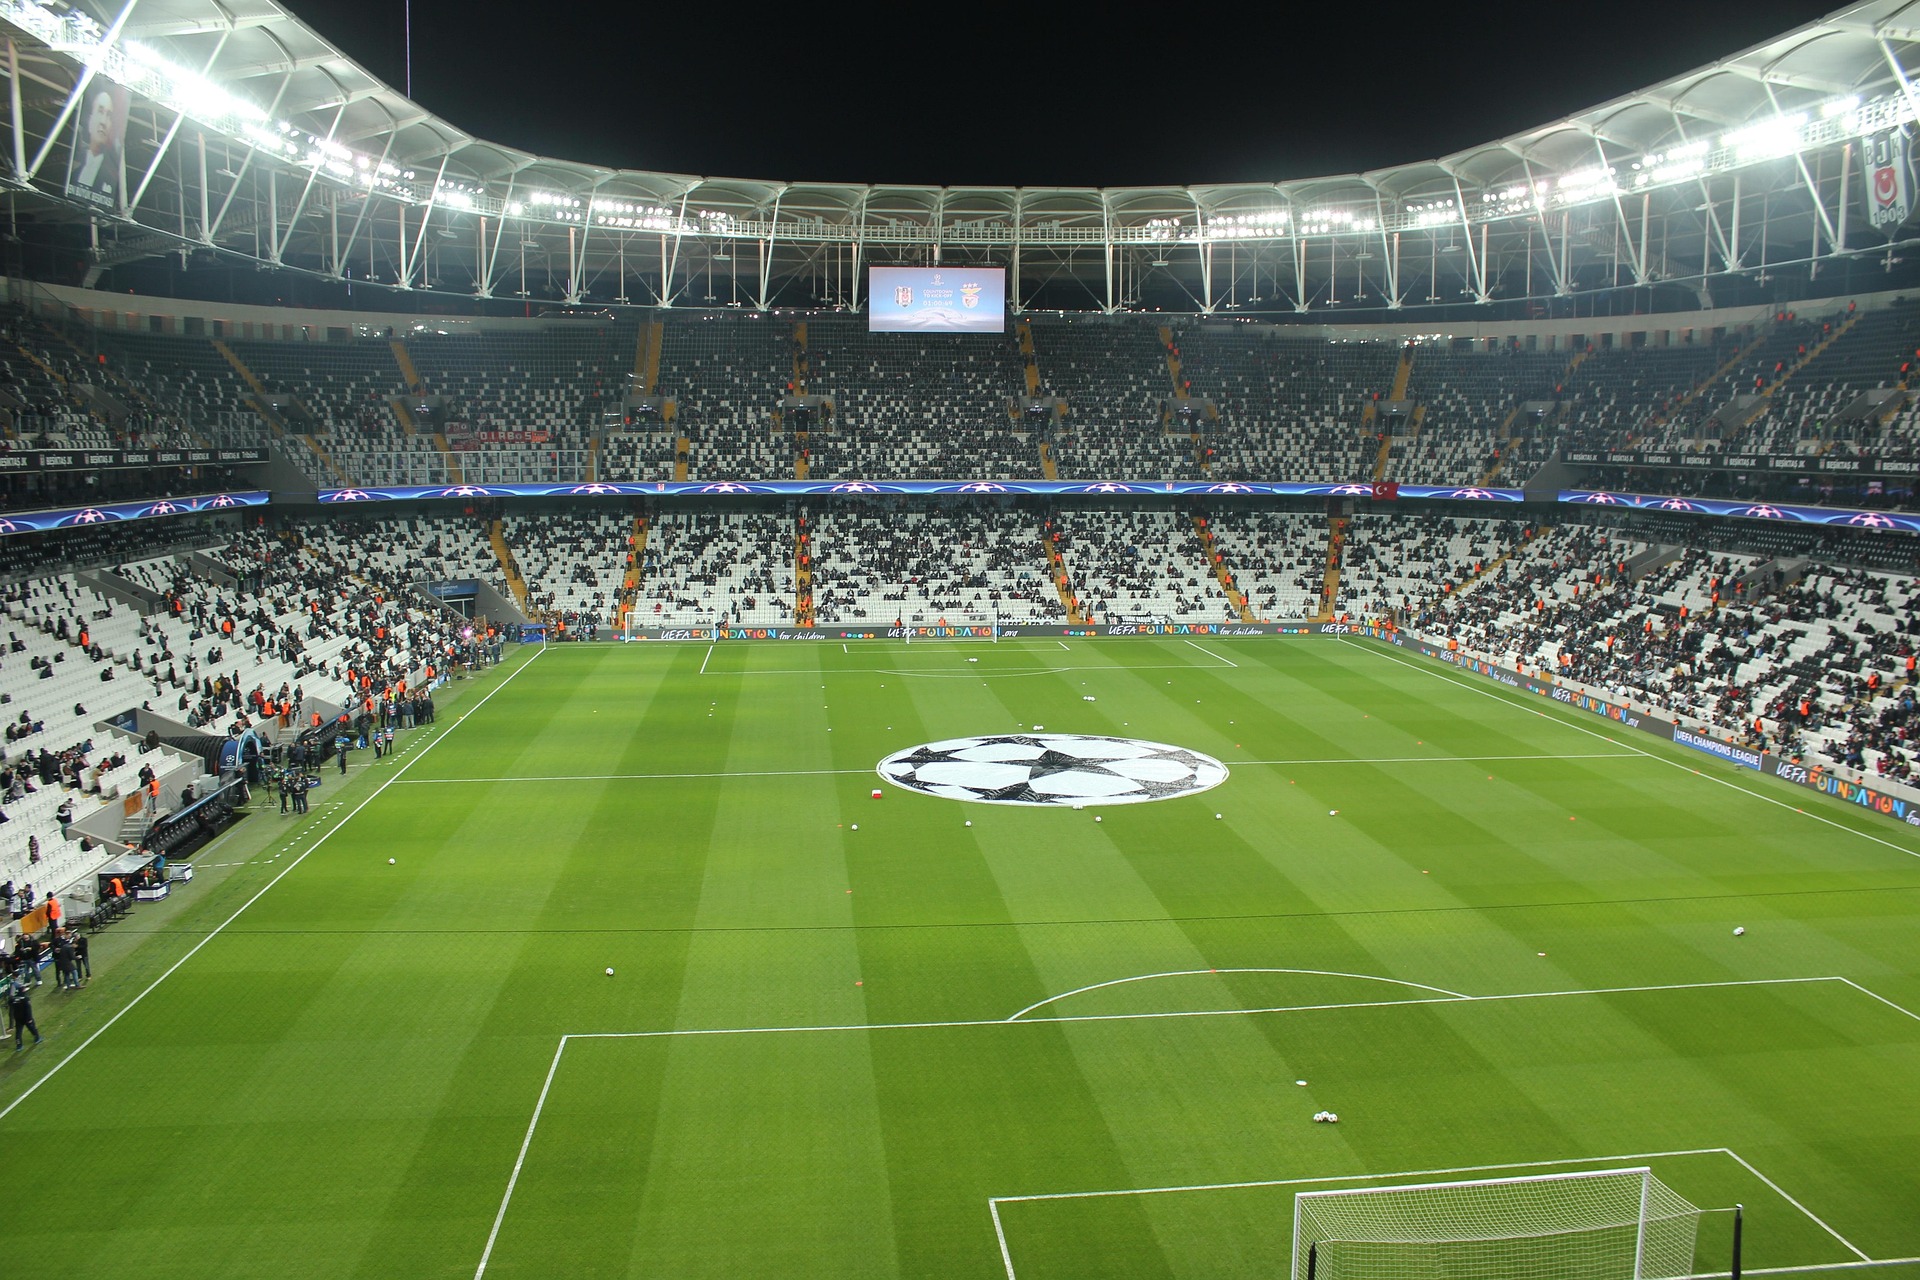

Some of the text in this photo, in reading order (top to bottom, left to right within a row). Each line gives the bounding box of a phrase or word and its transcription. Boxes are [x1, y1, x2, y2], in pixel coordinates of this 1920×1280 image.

[1873, 206, 1906, 225] 1903
[661, 630, 690, 639] UEFA
[692, 629, 776, 639] FOUNDATION
[888, 628, 916, 637] UEFA
[1109, 625, 1263, 635] UEFA FOUNDATION for children
[1321, 624, 1349, 634] UEFA
[1440, 650, 1454, 662] UEFA
[1552, 687, 1571, 702] UEFA
[1571, 693, 1627, 722] FOUNDATION
[1677, 729, 1759, 765] UEFA CHAMPIONS LEAGUE
[1776, 762, 1808, 784] UEFA
[1808, 772, 1905, 818] FOUNDATION
